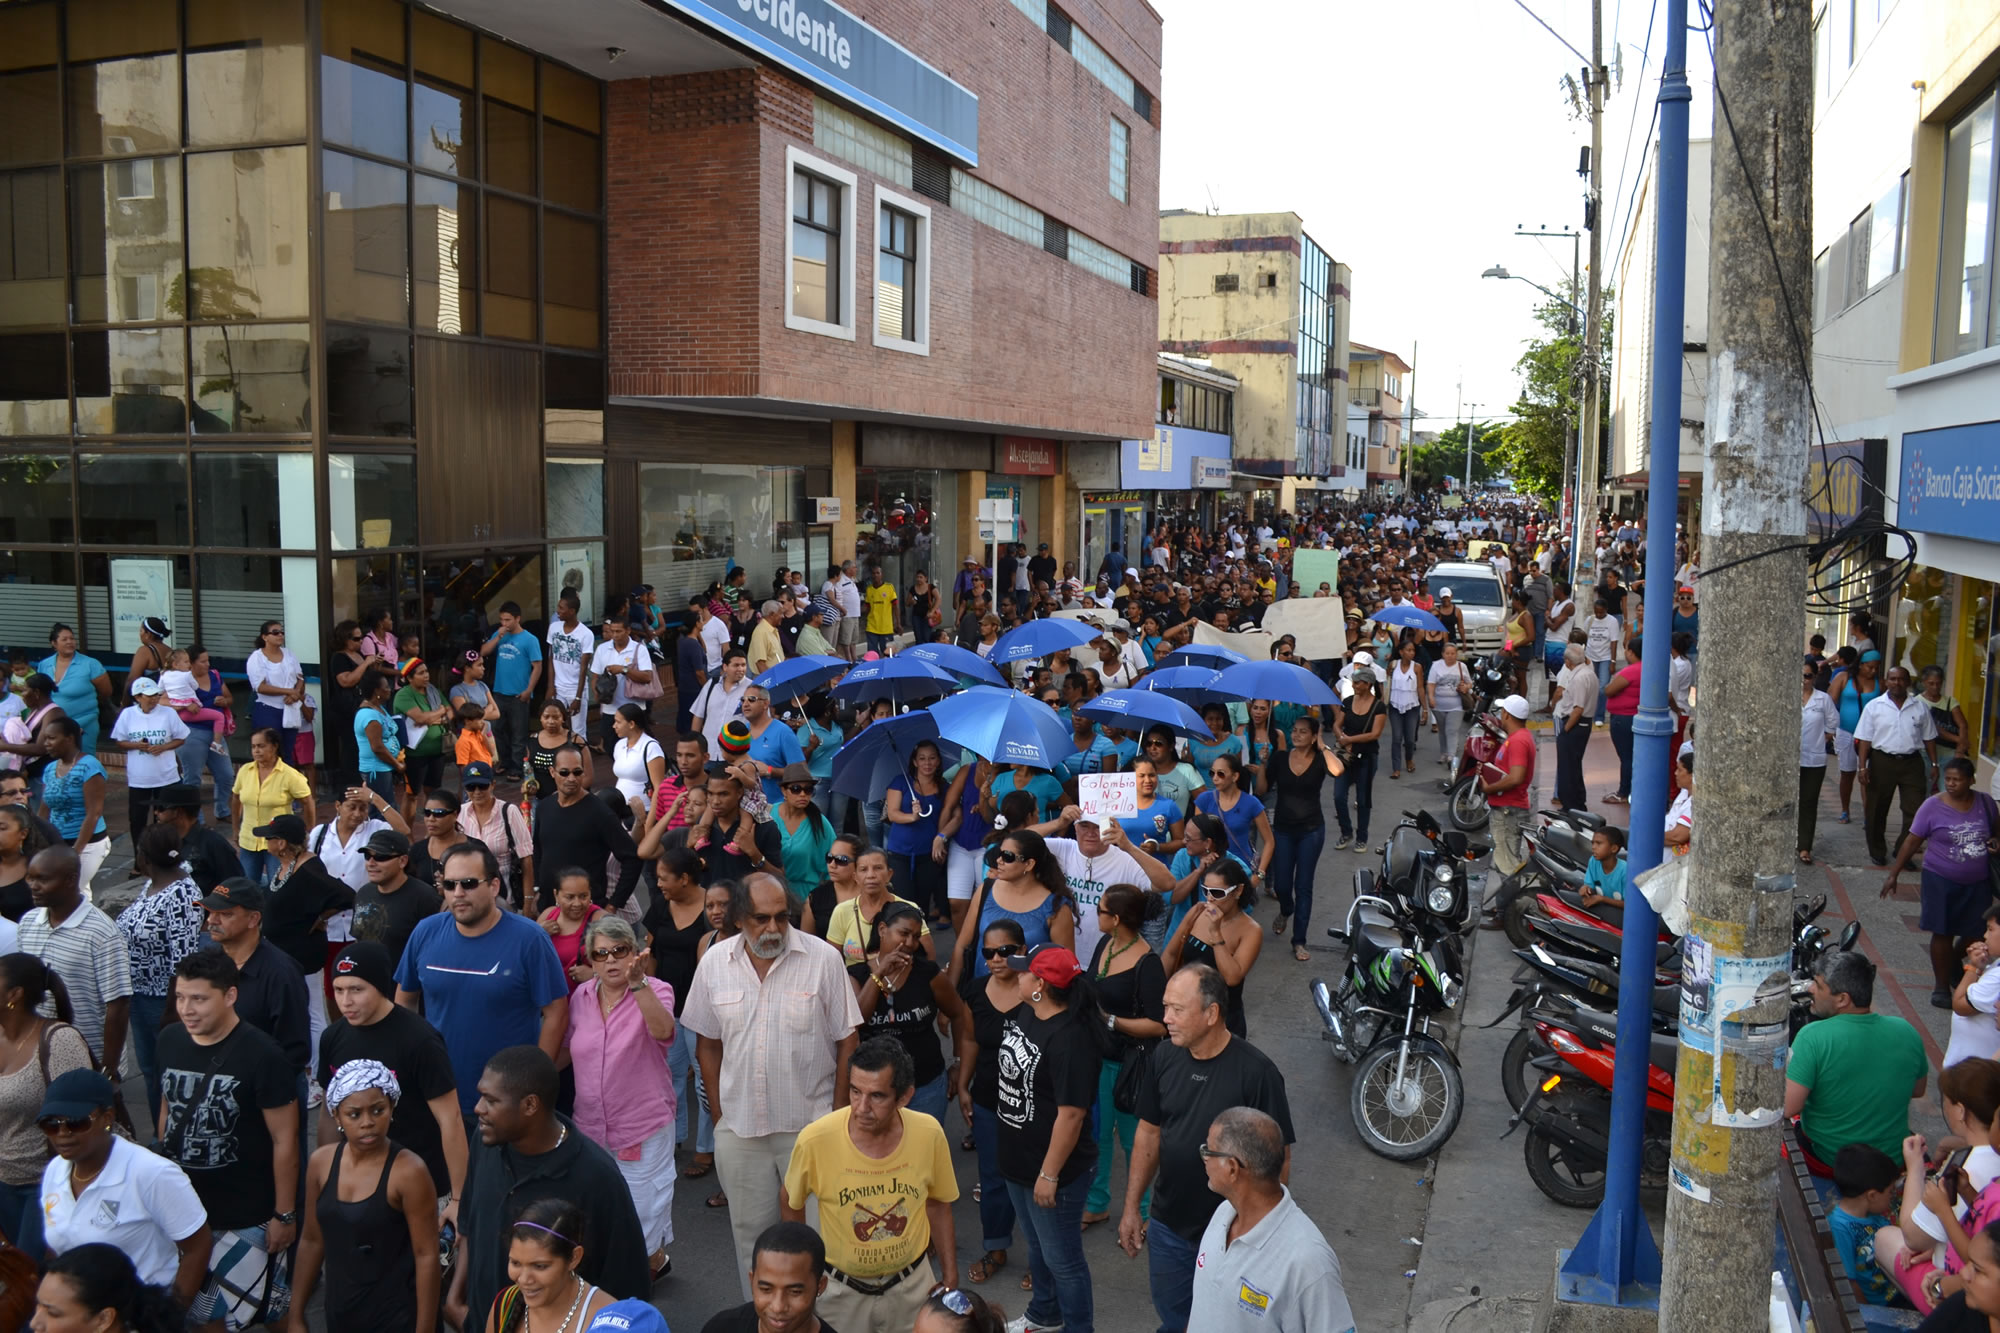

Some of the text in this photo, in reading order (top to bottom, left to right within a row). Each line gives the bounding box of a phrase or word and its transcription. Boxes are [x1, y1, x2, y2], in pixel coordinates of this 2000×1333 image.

[1926, 467, 1951, 498] Banco
[1952, 466, 1973, 507] Caja
[1006, 746, 1040, 757] NEVADA
[1080, 775, 1136, 789] Colombia
[1102, 790, 1122, 800] NO
[1065, 875, 1105, 892] SACATO
[1072, 892, 1102, 906] ALLO
[1591, 1025, 1616, 1040] auteco
[839, 1177, 919, 1207] BONHAM JEANS
[854, 1248, 882, 1257] FLORIDA
[859, 1256, 878, 1265] ROCK
[890, 1249, 906, 1259] ROLL
